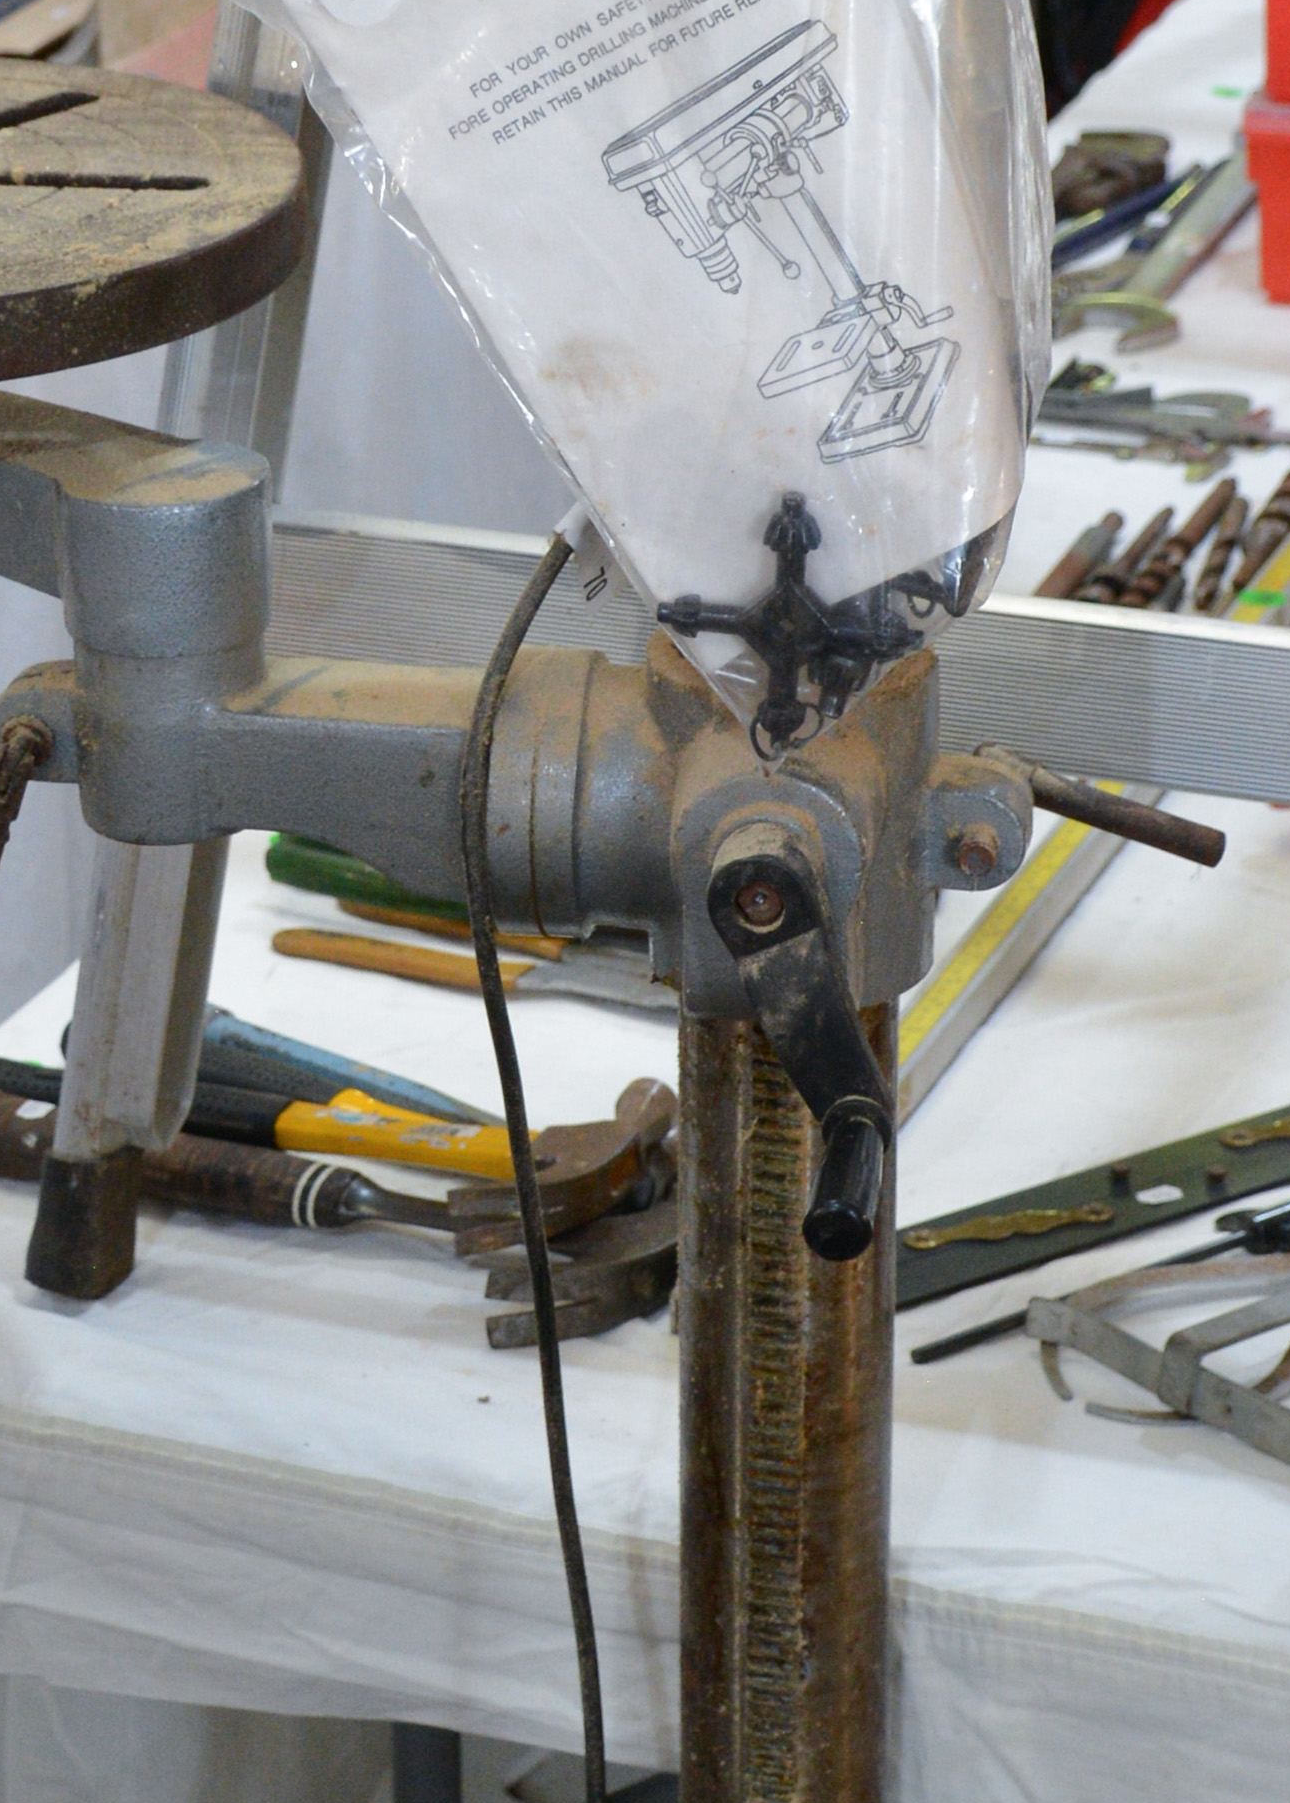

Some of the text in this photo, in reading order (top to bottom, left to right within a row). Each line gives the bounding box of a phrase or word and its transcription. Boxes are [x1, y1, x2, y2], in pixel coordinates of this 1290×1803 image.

[448, 108, 491, 141] FORE
[492, 59, 577, 116] OPERATING
[577, 21, 647, 67] DRILLING
[469, 72, 503, 99] FOR
[505, 45, 550, 77] YOUR
[554, 21, 593, 50] OWN
[492, 105, 547, 146] RETAIN
[547, 85, 584, 113] THIS
[583, 52, 648, 94] MANUAL
[648, 33, 678, 58] FOR
